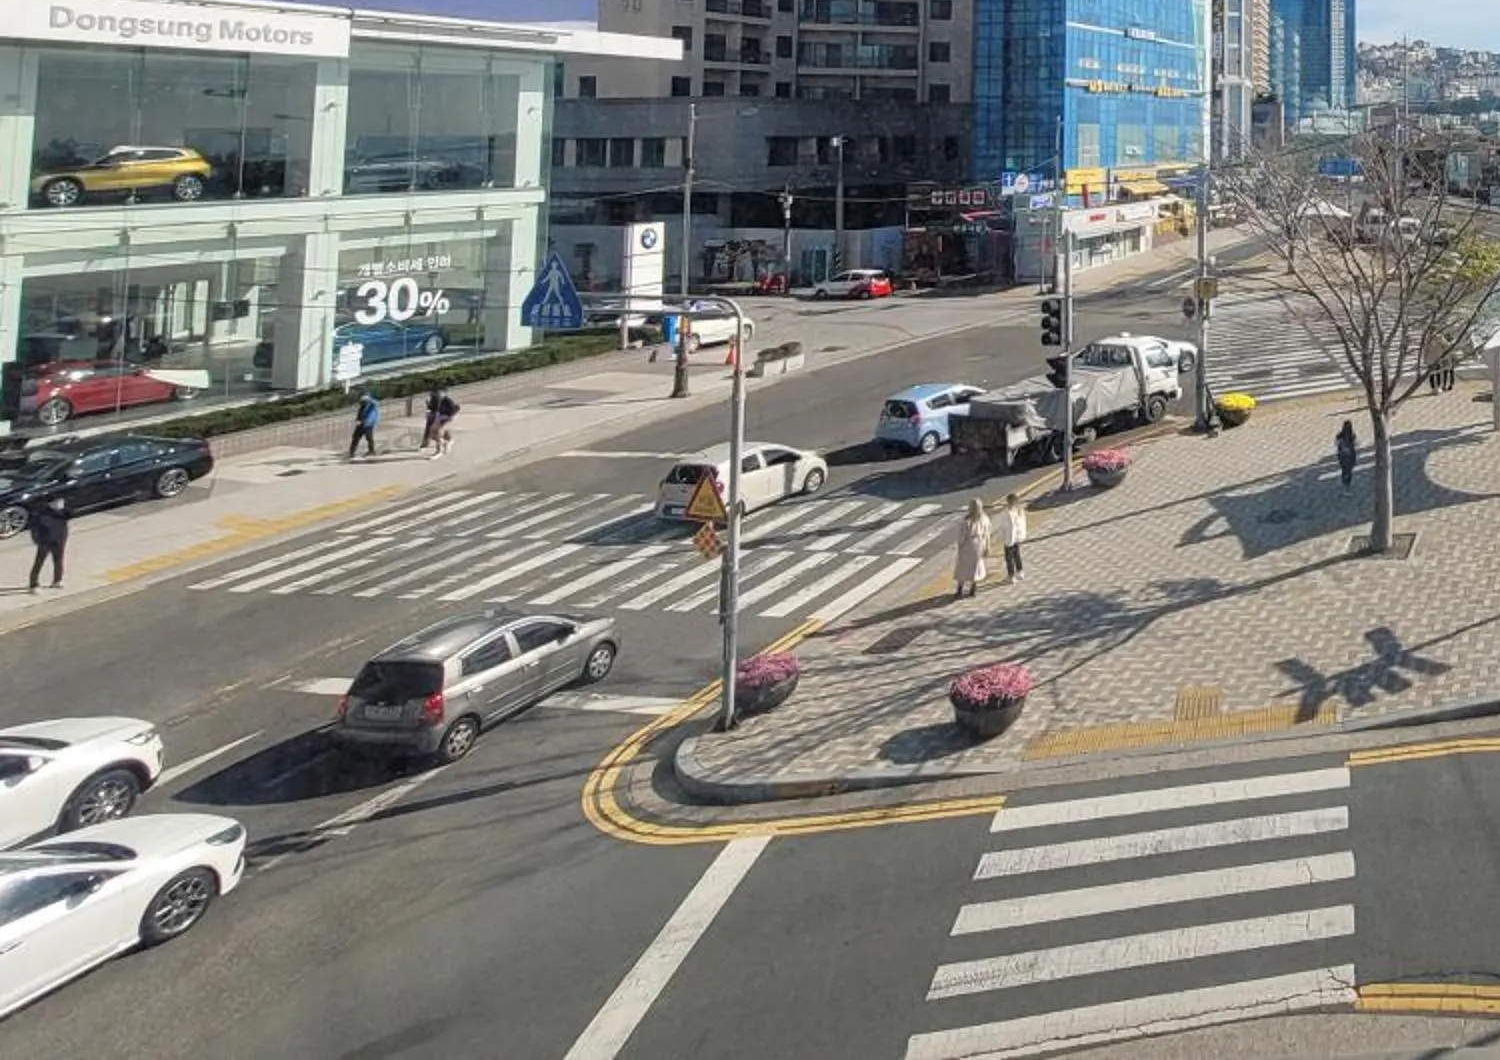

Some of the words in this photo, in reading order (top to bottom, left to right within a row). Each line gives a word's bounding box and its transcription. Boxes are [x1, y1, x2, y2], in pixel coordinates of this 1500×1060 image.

[49, 5, 213, 42] Dongsung
[218, 19, 314, 45] Motors
[354, 277, 450, 325] 30%
